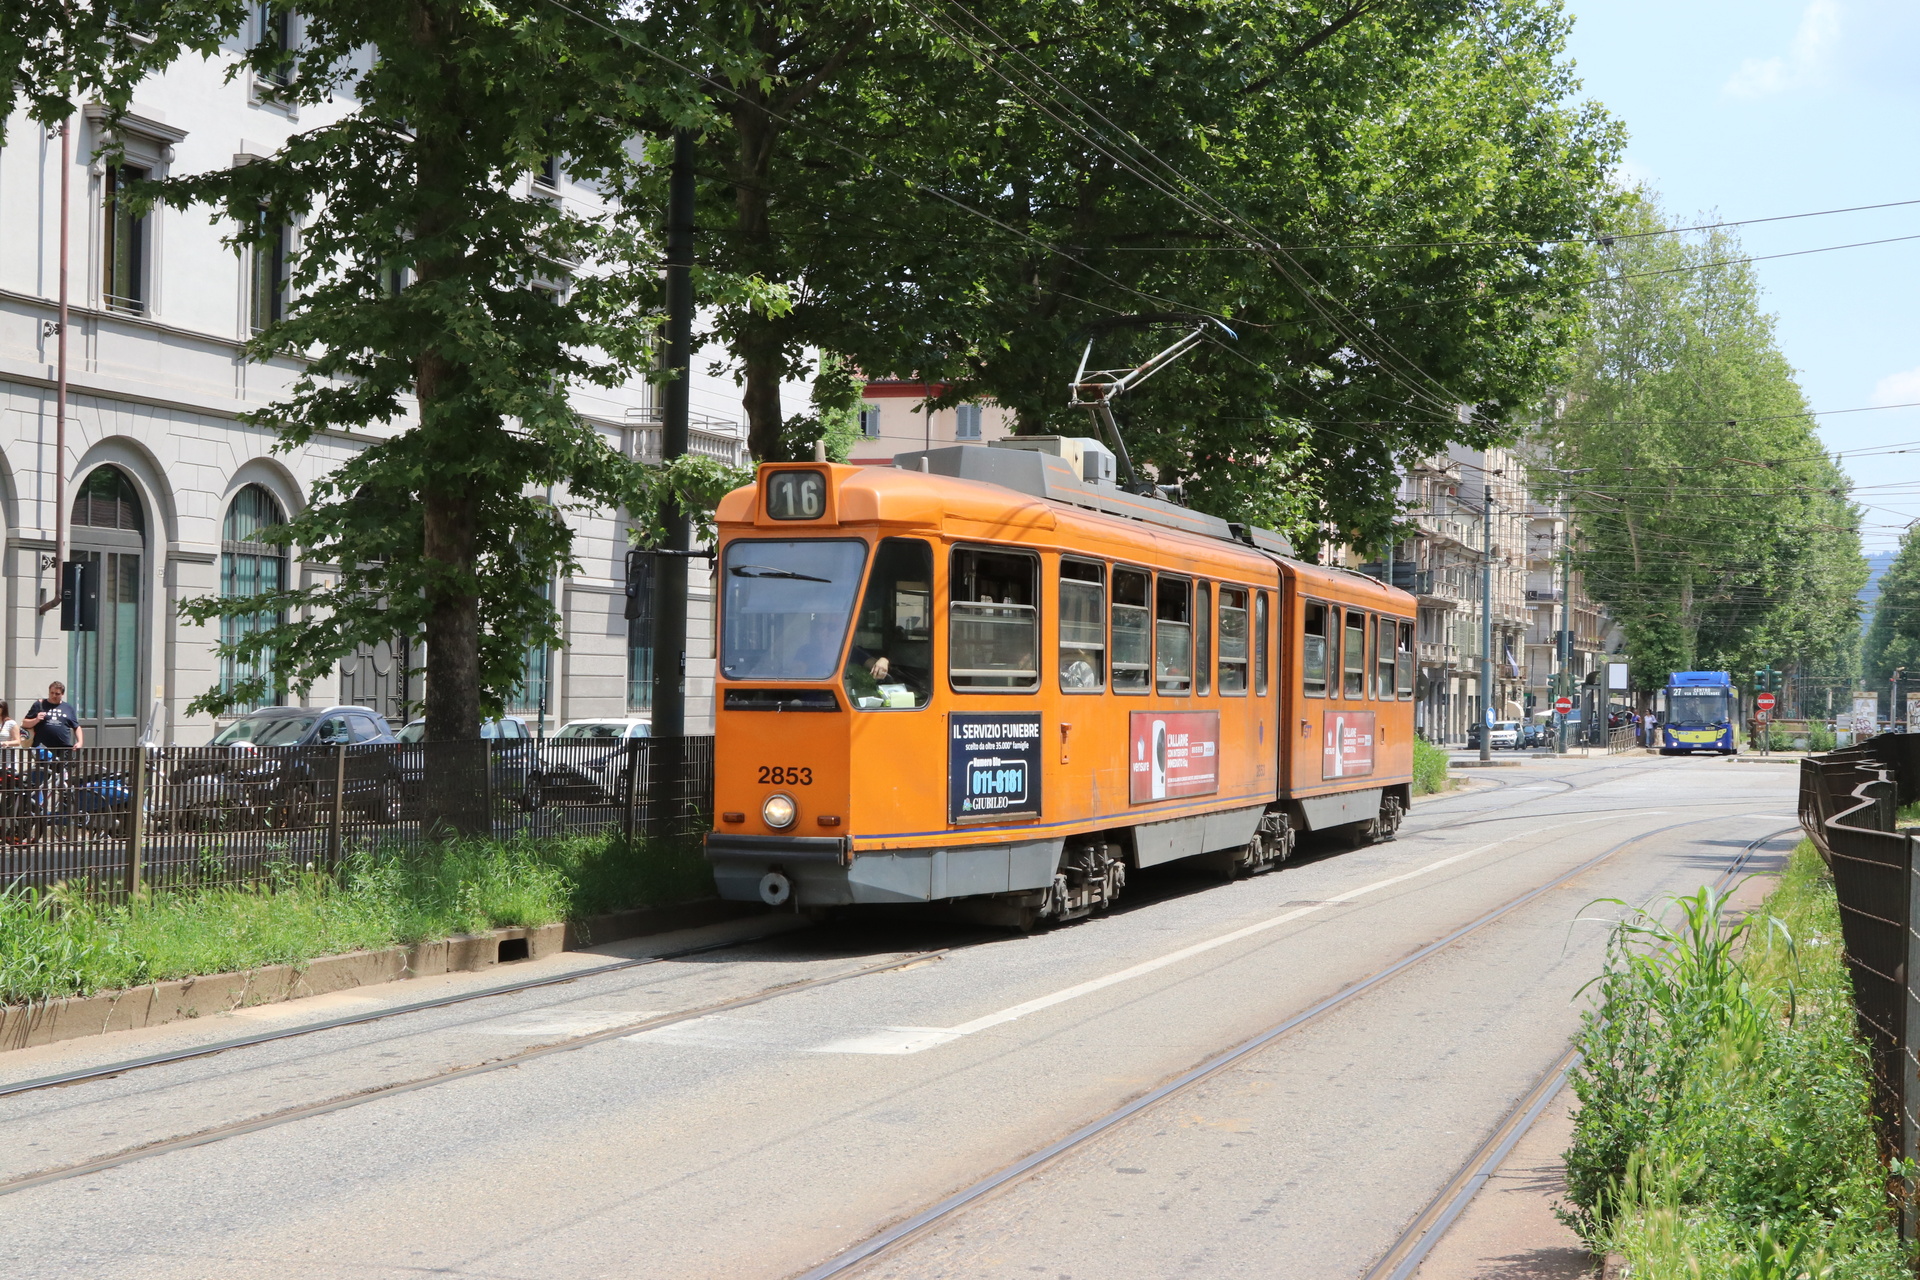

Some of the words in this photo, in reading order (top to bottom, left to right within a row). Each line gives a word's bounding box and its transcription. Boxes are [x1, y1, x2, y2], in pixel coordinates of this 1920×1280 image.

[782, 480, 819, 516] 16
[1673, 688, 1682, 696] 27
[953, 724, 962, 739] IL
[962, 723, 1001, 739] SERVIZIO
[1002, 723, 1039, 738] FUNEBRE
[965, 742, 979, 751] scelto
[979, 742, 985, 750] da
[985, 742, 996, 750] oltre
[1012, 740, 1029, 751] famiglie
[973, 757, 992, 767] Numero
[758, 766, 813, 785] 2853
[973, 769, 1022, 795] 011-8181
[972, 796, 1009, 811] GIUBILEO
